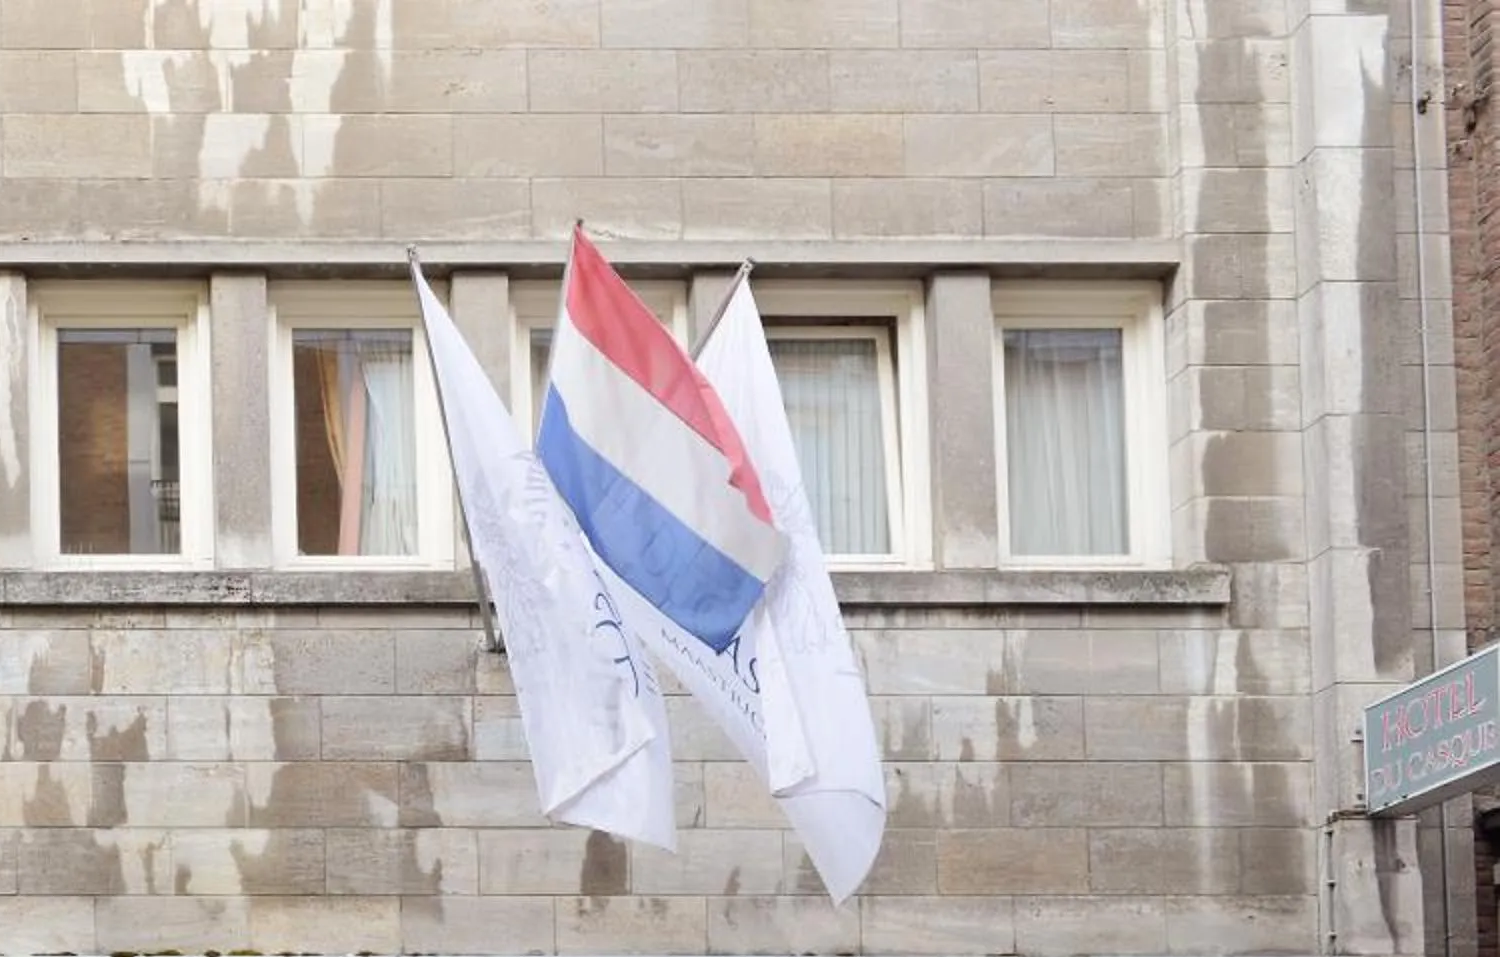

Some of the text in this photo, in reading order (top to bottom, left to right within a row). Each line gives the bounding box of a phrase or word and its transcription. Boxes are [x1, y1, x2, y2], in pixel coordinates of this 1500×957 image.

[1381, 670, 1487, 753] HOTEL
[1369, 719, 1497, 797] DU CASQUE
